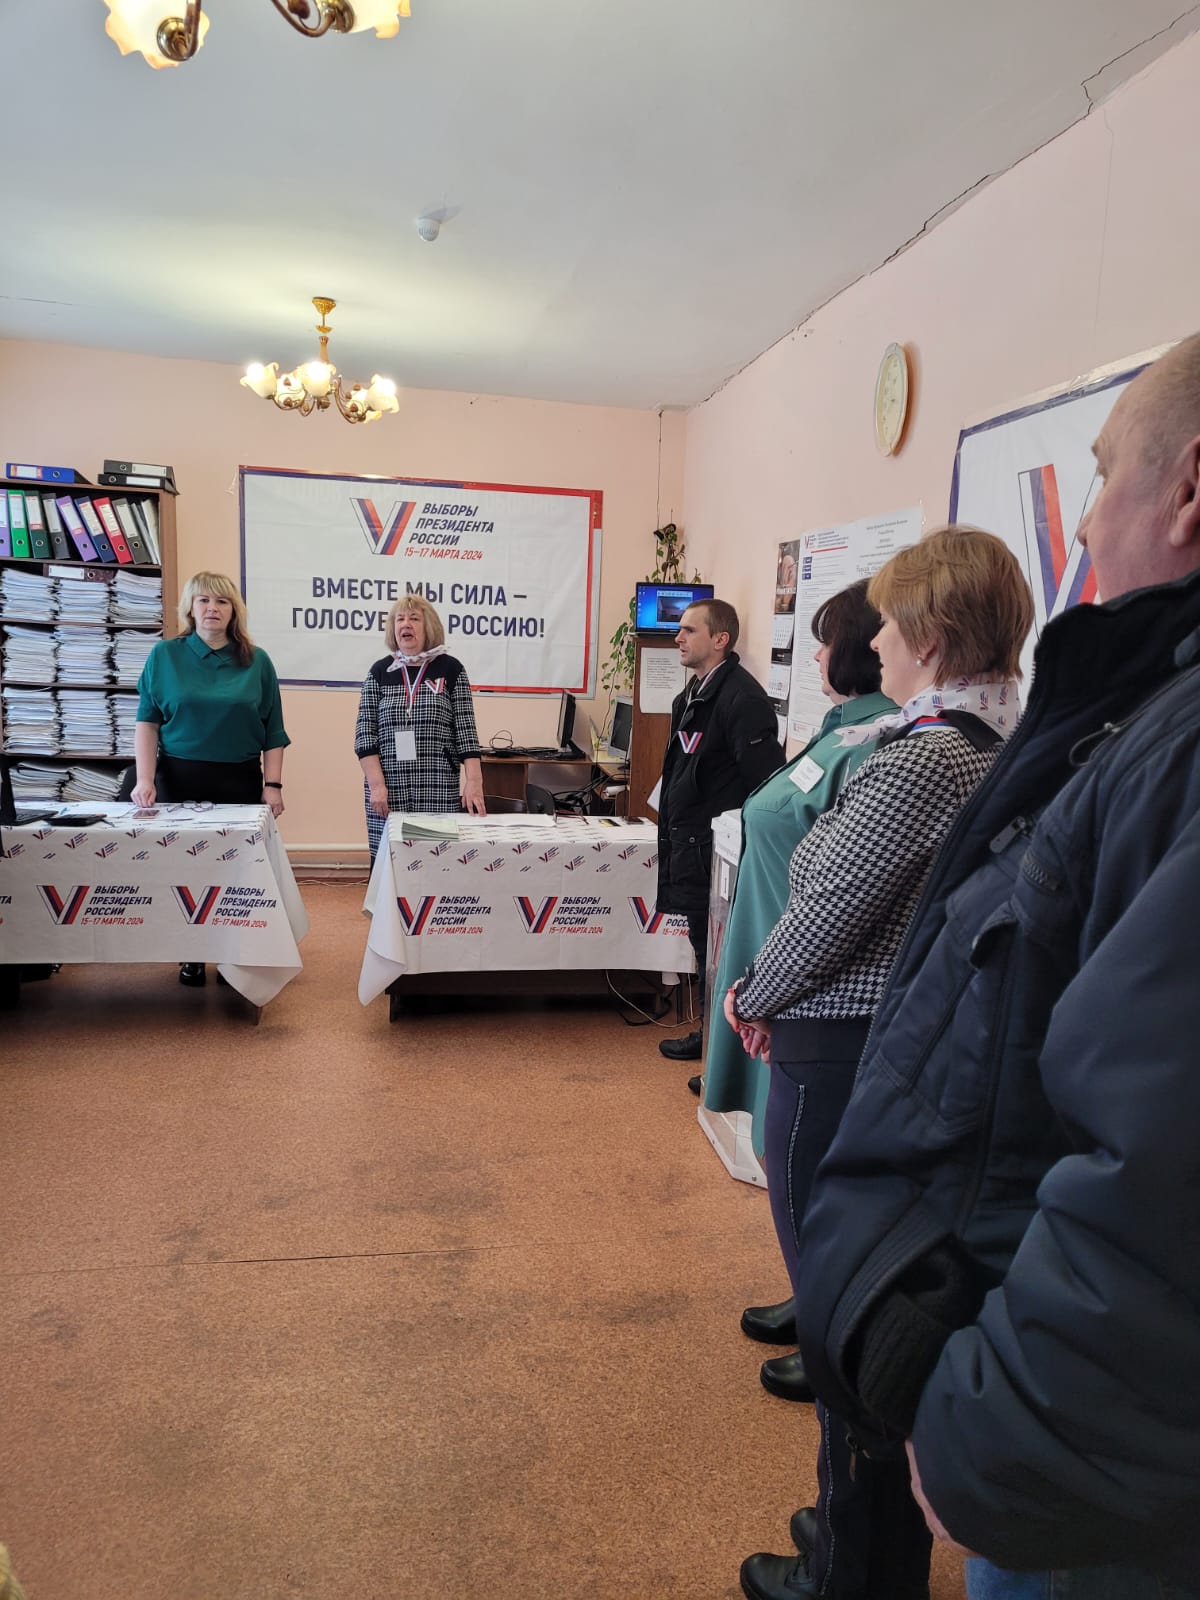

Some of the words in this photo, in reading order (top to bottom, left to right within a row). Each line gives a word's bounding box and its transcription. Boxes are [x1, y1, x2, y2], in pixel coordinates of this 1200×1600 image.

[422, 502, 479, 517] ВЫБОРЫ
[415, 518, 494, 533] ПРЕЗИДЕНТА
[409, 533, 460, 546] РОССИИ
[429, 548, 460, 560] МАРТА
[460, 549, 483, 561] 2024
[312, 576, 399, 601] ВМЕСТЕ
[405, 581, 443, 603] МЫ
[450, 583, 507, 606] СИЛА
[292, 607, 389, 632] ГОЛОСУЕ
[448, 614, 545, 638] РОССИЮ!
[94, 885, 140, 895] ВЫБОРЫ
[225, 886, 265, 897] ВЫБОРЫ
[89, 896, 153, 906] ПРЕЗИДЕНТА
[219, 897, 277, 908] ПРЕЗИДЕНТА
[439, 895, 480, 904] ВЫБОРЫ
[561, 896, 602, 905] ВЫБОРЫ
[84, 907, 125, 916] РОССИИ
[215, 908, 251, 918] РОССИИ
[434, 906, 492, 915] ПРЕЗИДЕНТА
[556, 906, 612, 916] ПРЕЗИДЕНТА
[101, 917, 126, 926] МАРТА
[126, 917, 144, 926] 2024
[229, 919, 250, 928] МАРТА
[250, 920, 268, 928] 2024
[430, 916, 467, 925] РОССИИ
[552, 916, 588, 925] РОССИИ
[665, 918, 689, 928] РОСС
[444, 926, 467, 935] МАРТА
[467, 926, 484, 934] 2024
[566, 926, 588, 934] МАРТА
[588, 926, 604, 934] 2024
